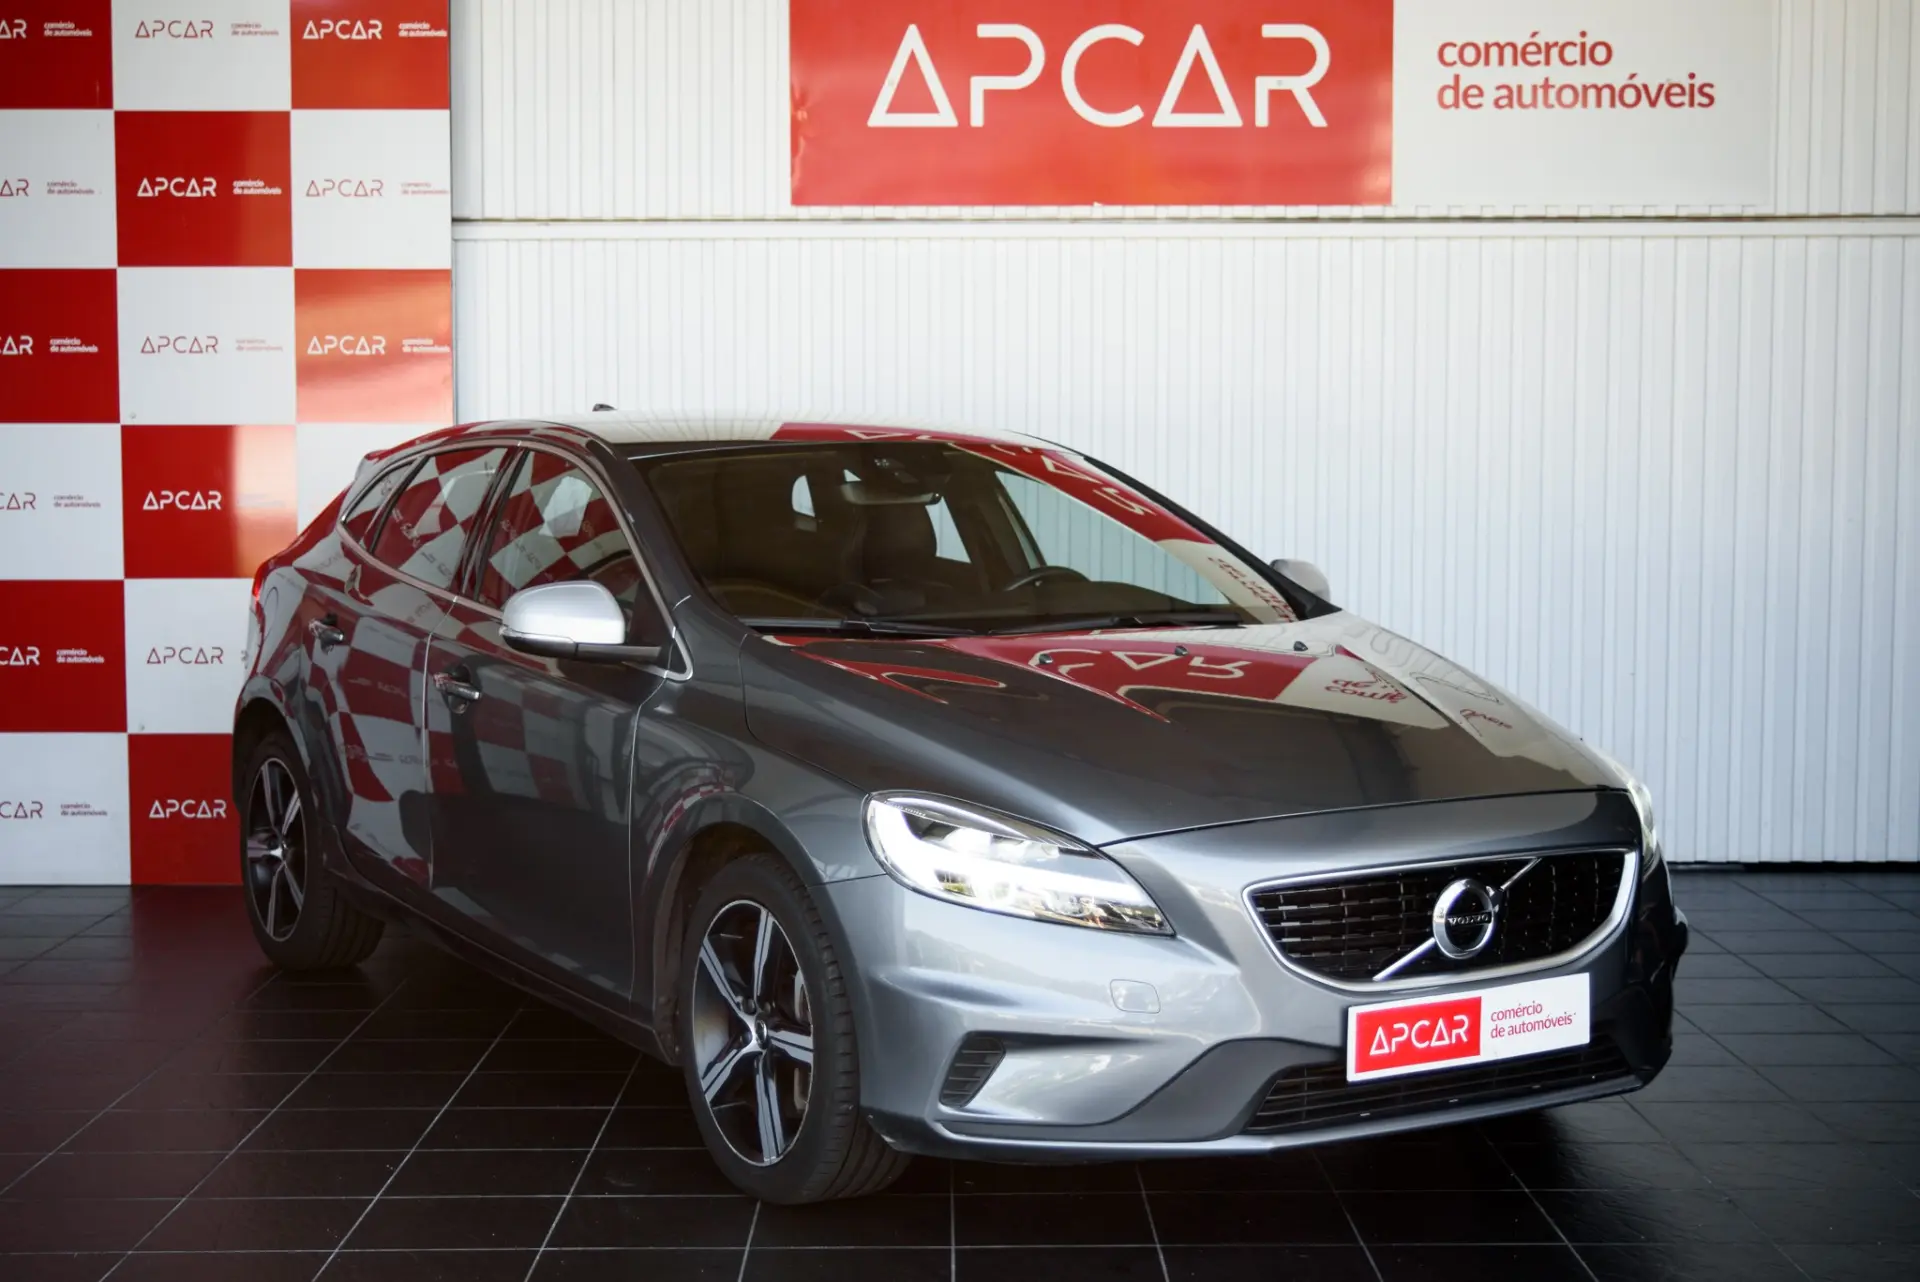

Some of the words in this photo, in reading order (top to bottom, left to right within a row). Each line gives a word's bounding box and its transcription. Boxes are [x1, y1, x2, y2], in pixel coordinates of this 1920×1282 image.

[135, 20, 213, 38] APCAR
[303, 19, 382, 40] APCAR
[1438, 31, 1612, 66] comércio
[867, 24, 1330, 127] APCAR
[1438, 73, 1485, 109] de
[1494, 72, 1715, 109] automóveis
[137, 177, 217, 197] APCAR
[306, 179, 383, 197] APCAR
[141, 335, 218, 354] APCAR
[307, 335, 386, 355] APCAR
[143, 490, 222, 510] APCAR
[147, 647, 223, 664] APCAR
[149, 799, 226, 819] APCAR
[1490, 1001, 1543, 1022] comércio
[1490, 1024, 1506, 1038] de
[1507, 1011, 1573, 1036] automóveis
[1370, 1014, 1470, 1056] APCAR
